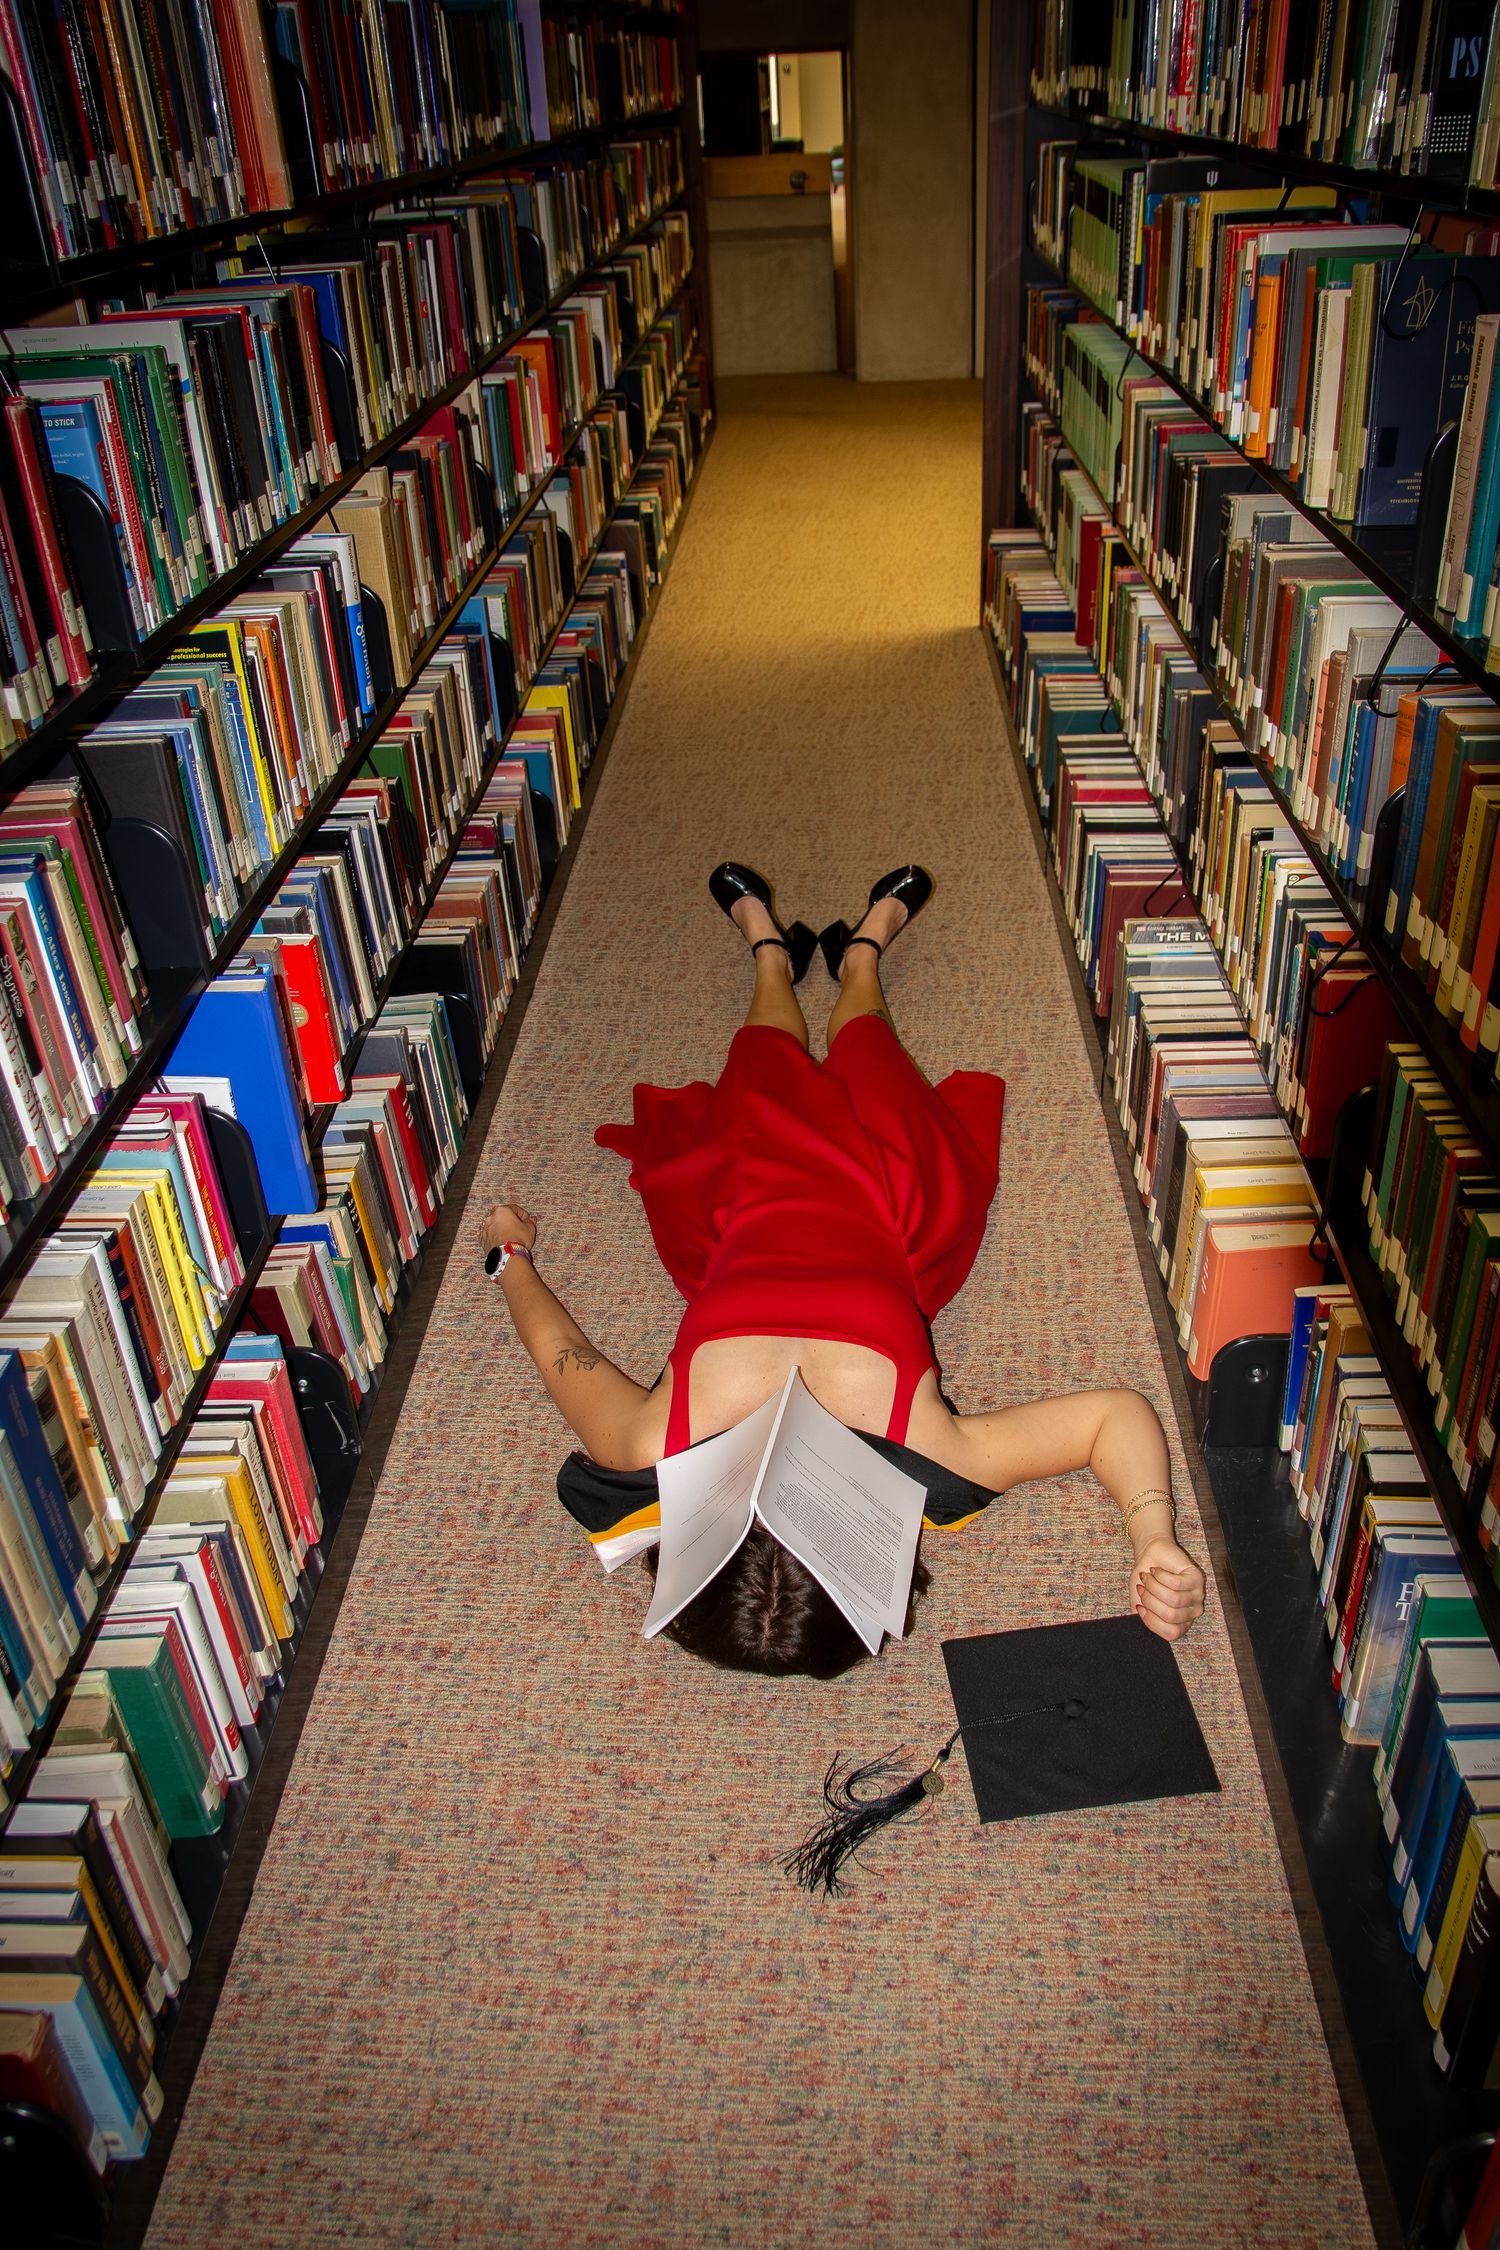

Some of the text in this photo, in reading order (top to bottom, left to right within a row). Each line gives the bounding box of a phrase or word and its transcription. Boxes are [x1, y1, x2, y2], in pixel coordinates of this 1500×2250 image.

[1448, 35, 1484, 79] PS
[1466, 336, 1486, 422] BARBARA HANNAH
[54, 417, 75, 426] STICK
[100, 445, 117, 514] SWITCH
[170, 650, 227, 660] professional success
[1155, 932, 1191, 942] THE
[1, 952, 24, 1019] Shyness
[35, 1012, 58, 1057] Crying
[20, 1088, 44, 1133] SHY
[138, 1208, 161, 1263] survivor
